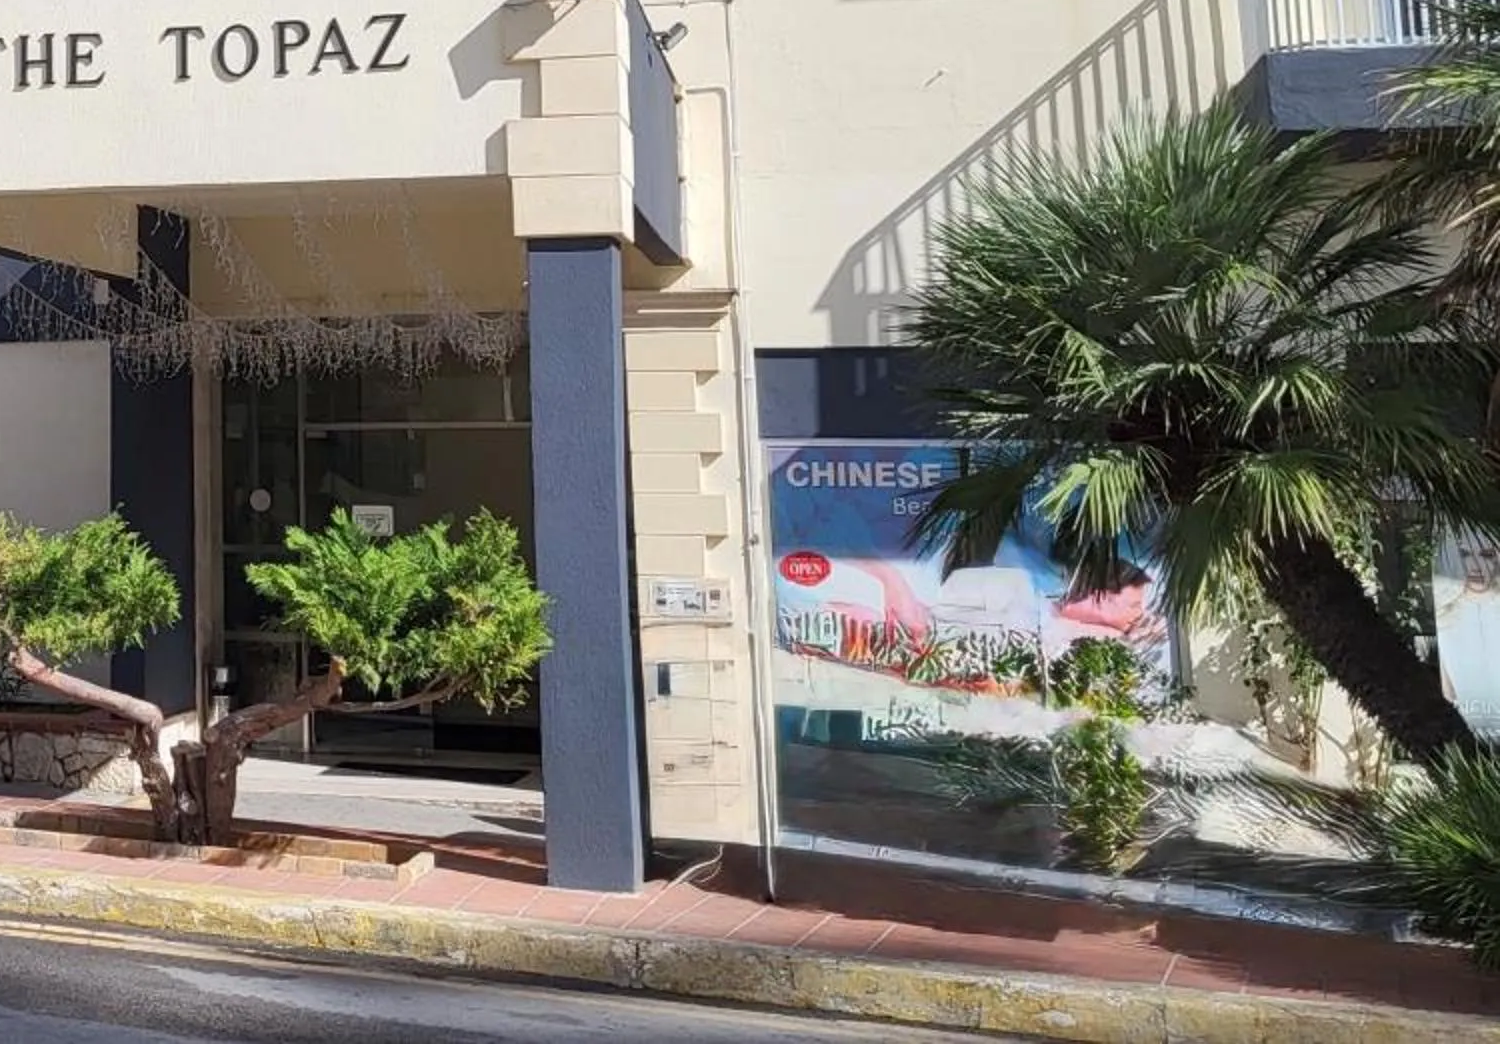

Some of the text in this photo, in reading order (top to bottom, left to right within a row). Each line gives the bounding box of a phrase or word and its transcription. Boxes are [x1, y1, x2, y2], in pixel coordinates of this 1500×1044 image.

[159, 13, 411, 83] TOPAZ
[786, 460, 943, 488] CHINESE
[788, 561, 823, 576] OPEN
